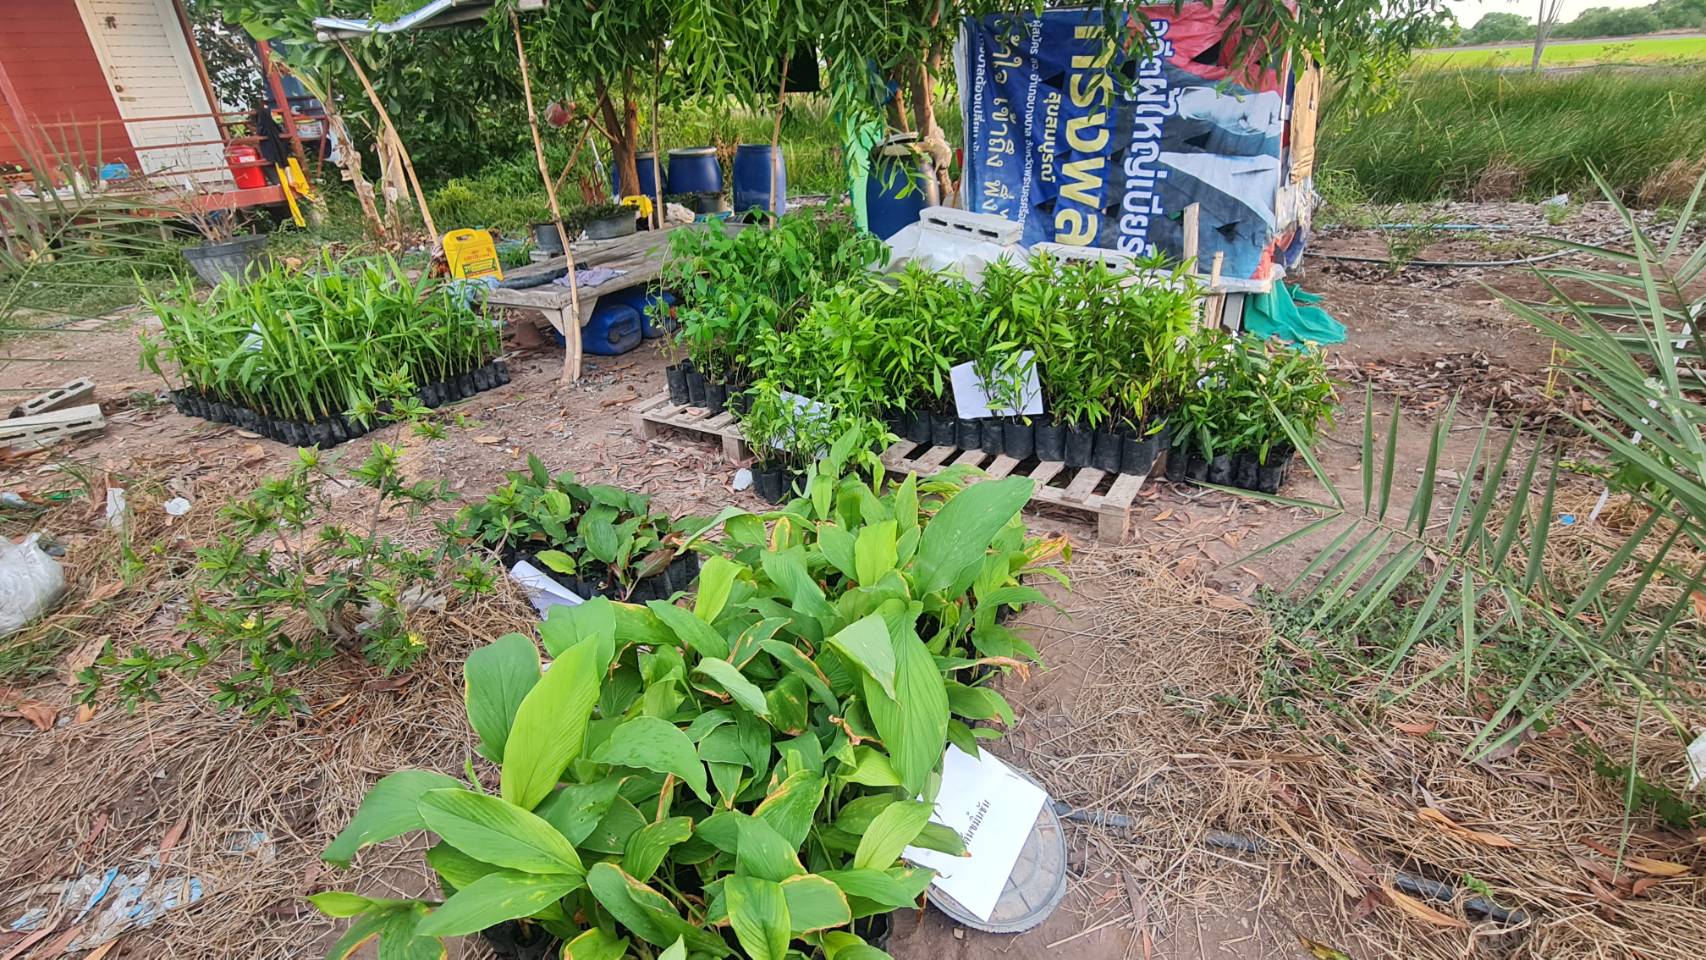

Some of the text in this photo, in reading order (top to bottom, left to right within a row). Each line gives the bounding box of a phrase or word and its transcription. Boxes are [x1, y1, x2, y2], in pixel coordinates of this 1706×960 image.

[986, 98, 1016, 167] เข้าถึง
[1038, 92, 1061, 183] สุขสมบูรณ์
